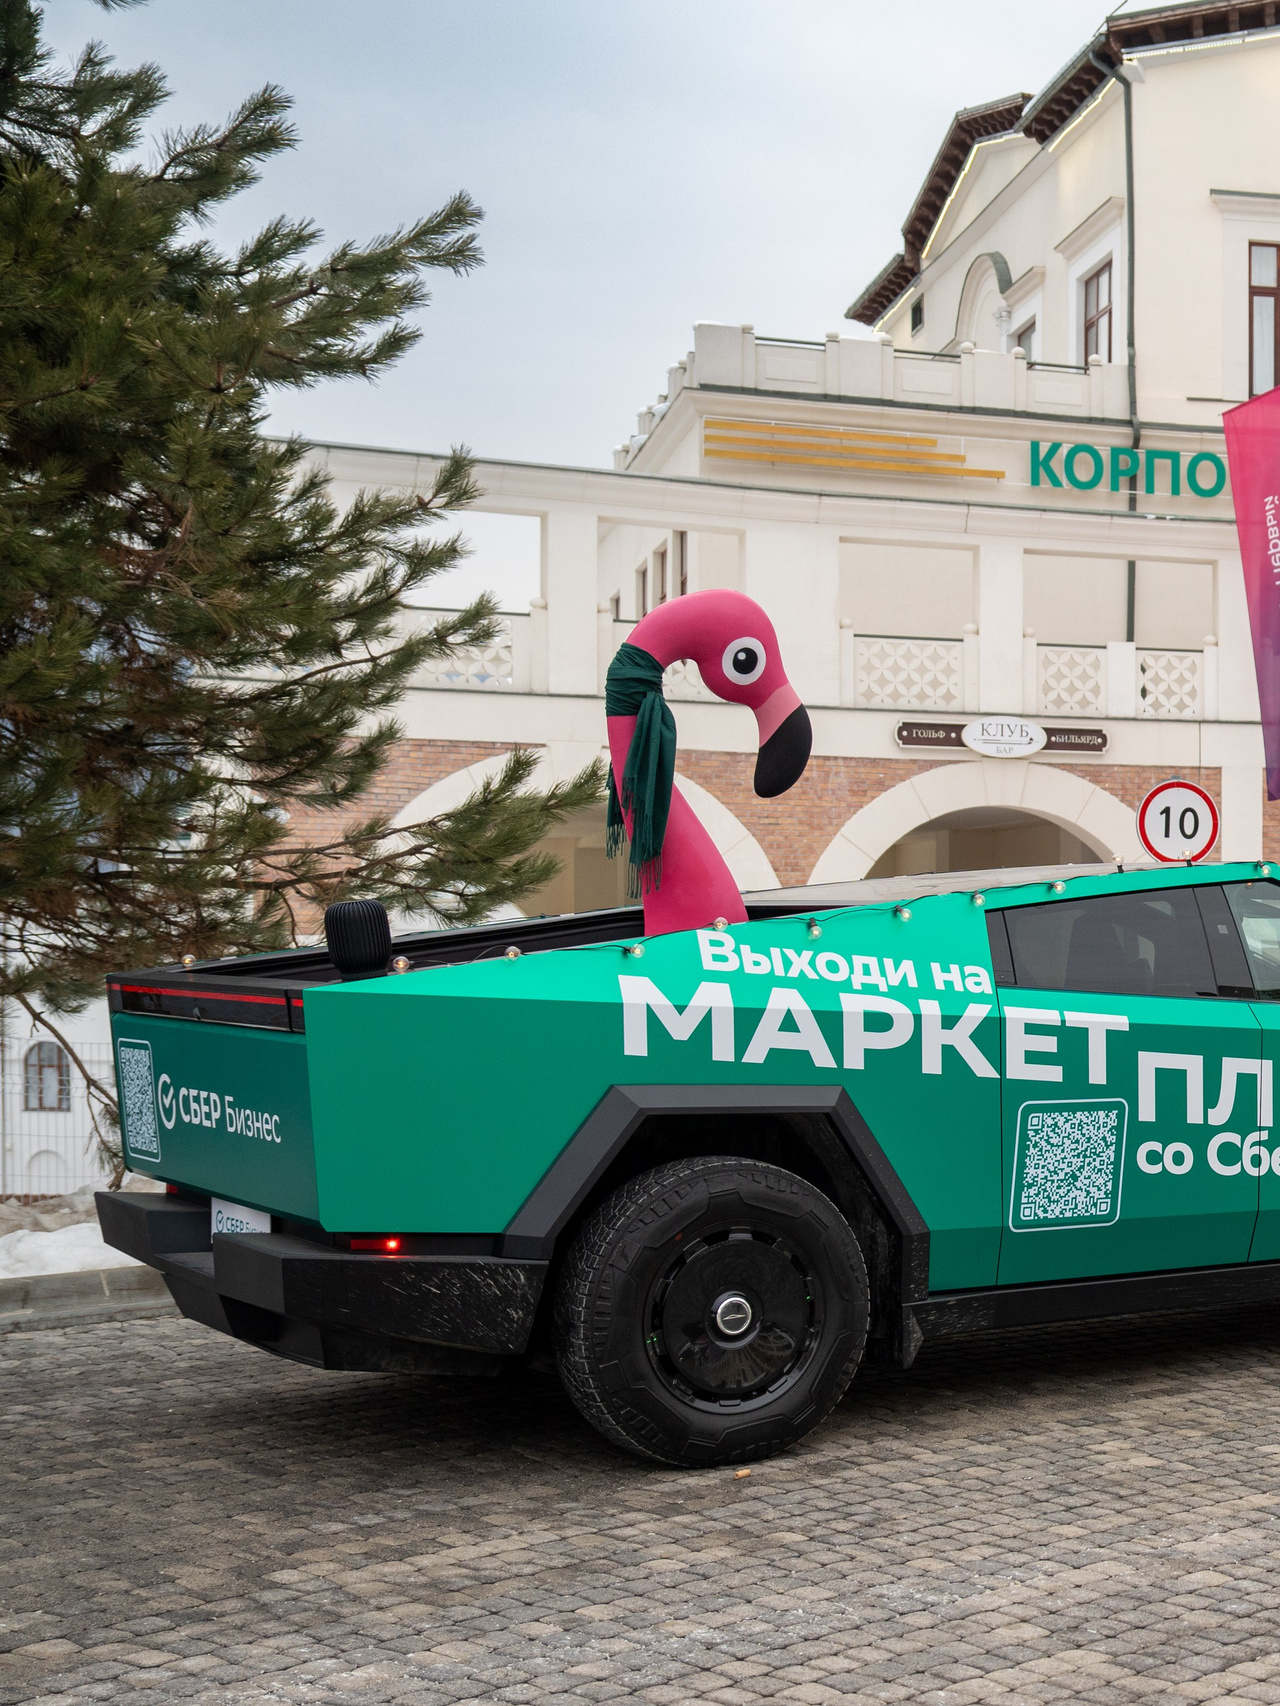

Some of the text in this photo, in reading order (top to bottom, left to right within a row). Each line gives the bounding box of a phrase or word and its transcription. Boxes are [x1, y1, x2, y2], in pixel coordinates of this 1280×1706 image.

[912, 728, 946, 739] ГОЛЬФ
[980, 723, 1029, 738] КЛУБ
[1055, 735, 1099, 745] БИЛЬЯРД
[996, 746, 1014, 754] БАР
[1159, 806, 1200, 840] 10
[696, 928, 993, 995] Выходи на
[179, 1086, 282, 1144] СБЕР Бизнес
[1136, 1140, 1194, 1175] со
